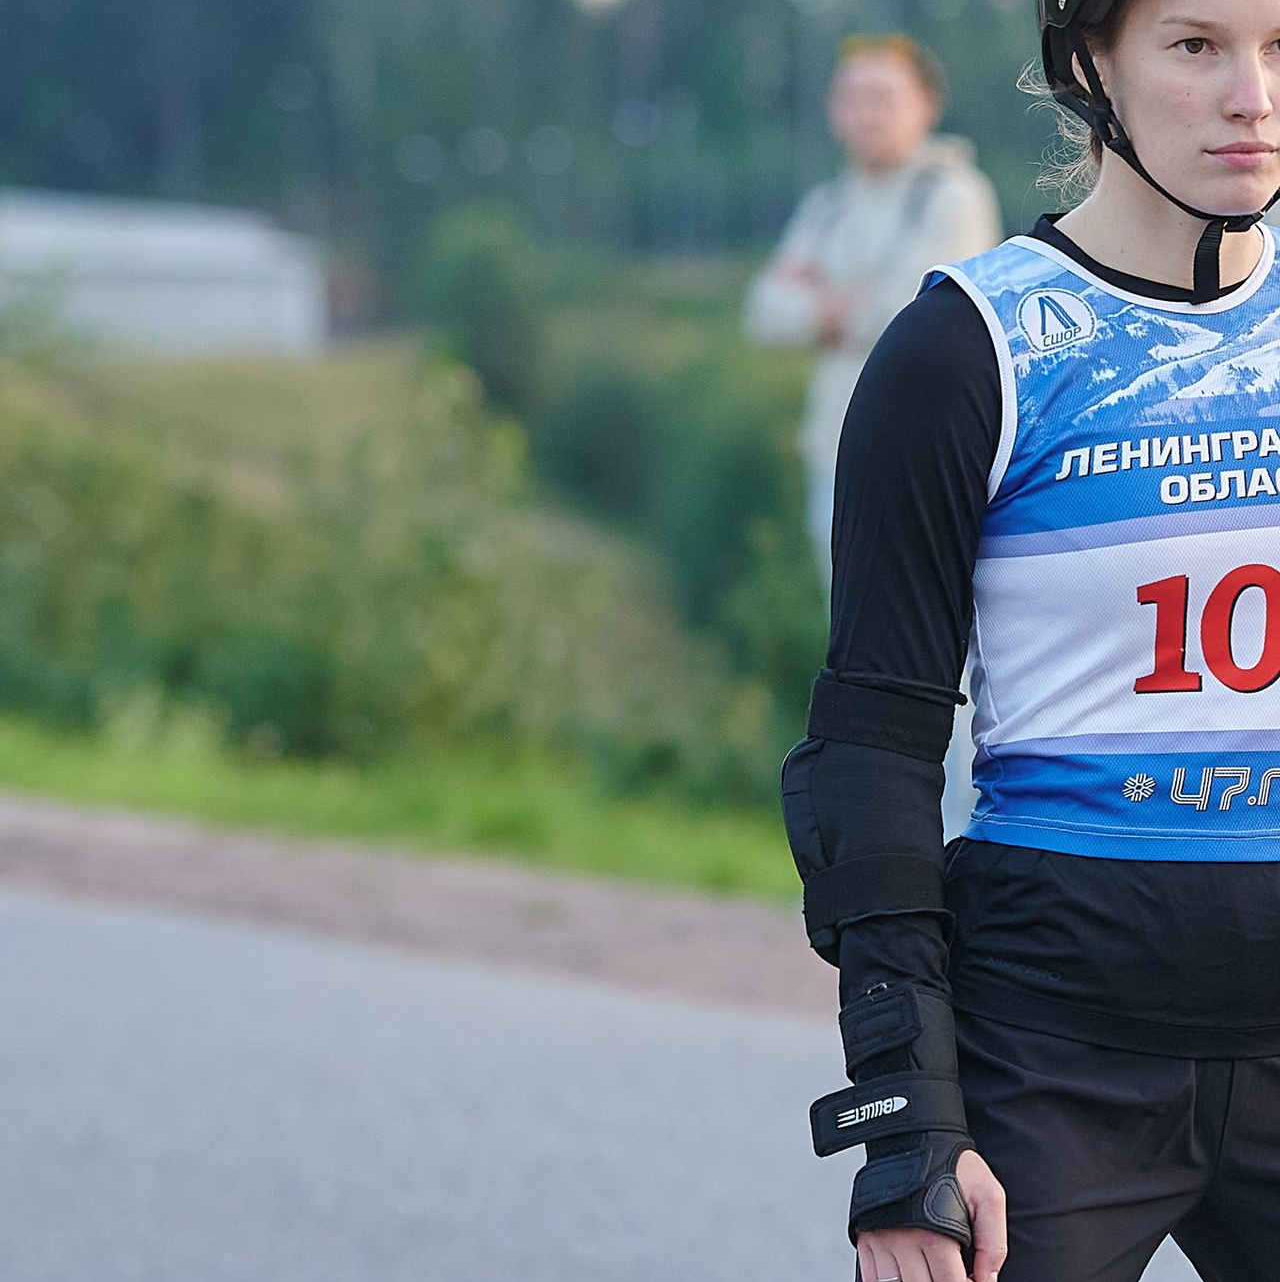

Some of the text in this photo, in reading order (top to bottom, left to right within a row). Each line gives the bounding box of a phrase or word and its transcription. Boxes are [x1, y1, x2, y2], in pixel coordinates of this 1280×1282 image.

[1043, 326, 1081, 347] СШОР
[1025, 966, 1060, 981] PRO
[838, 1098, 894, 1128] BULLET
